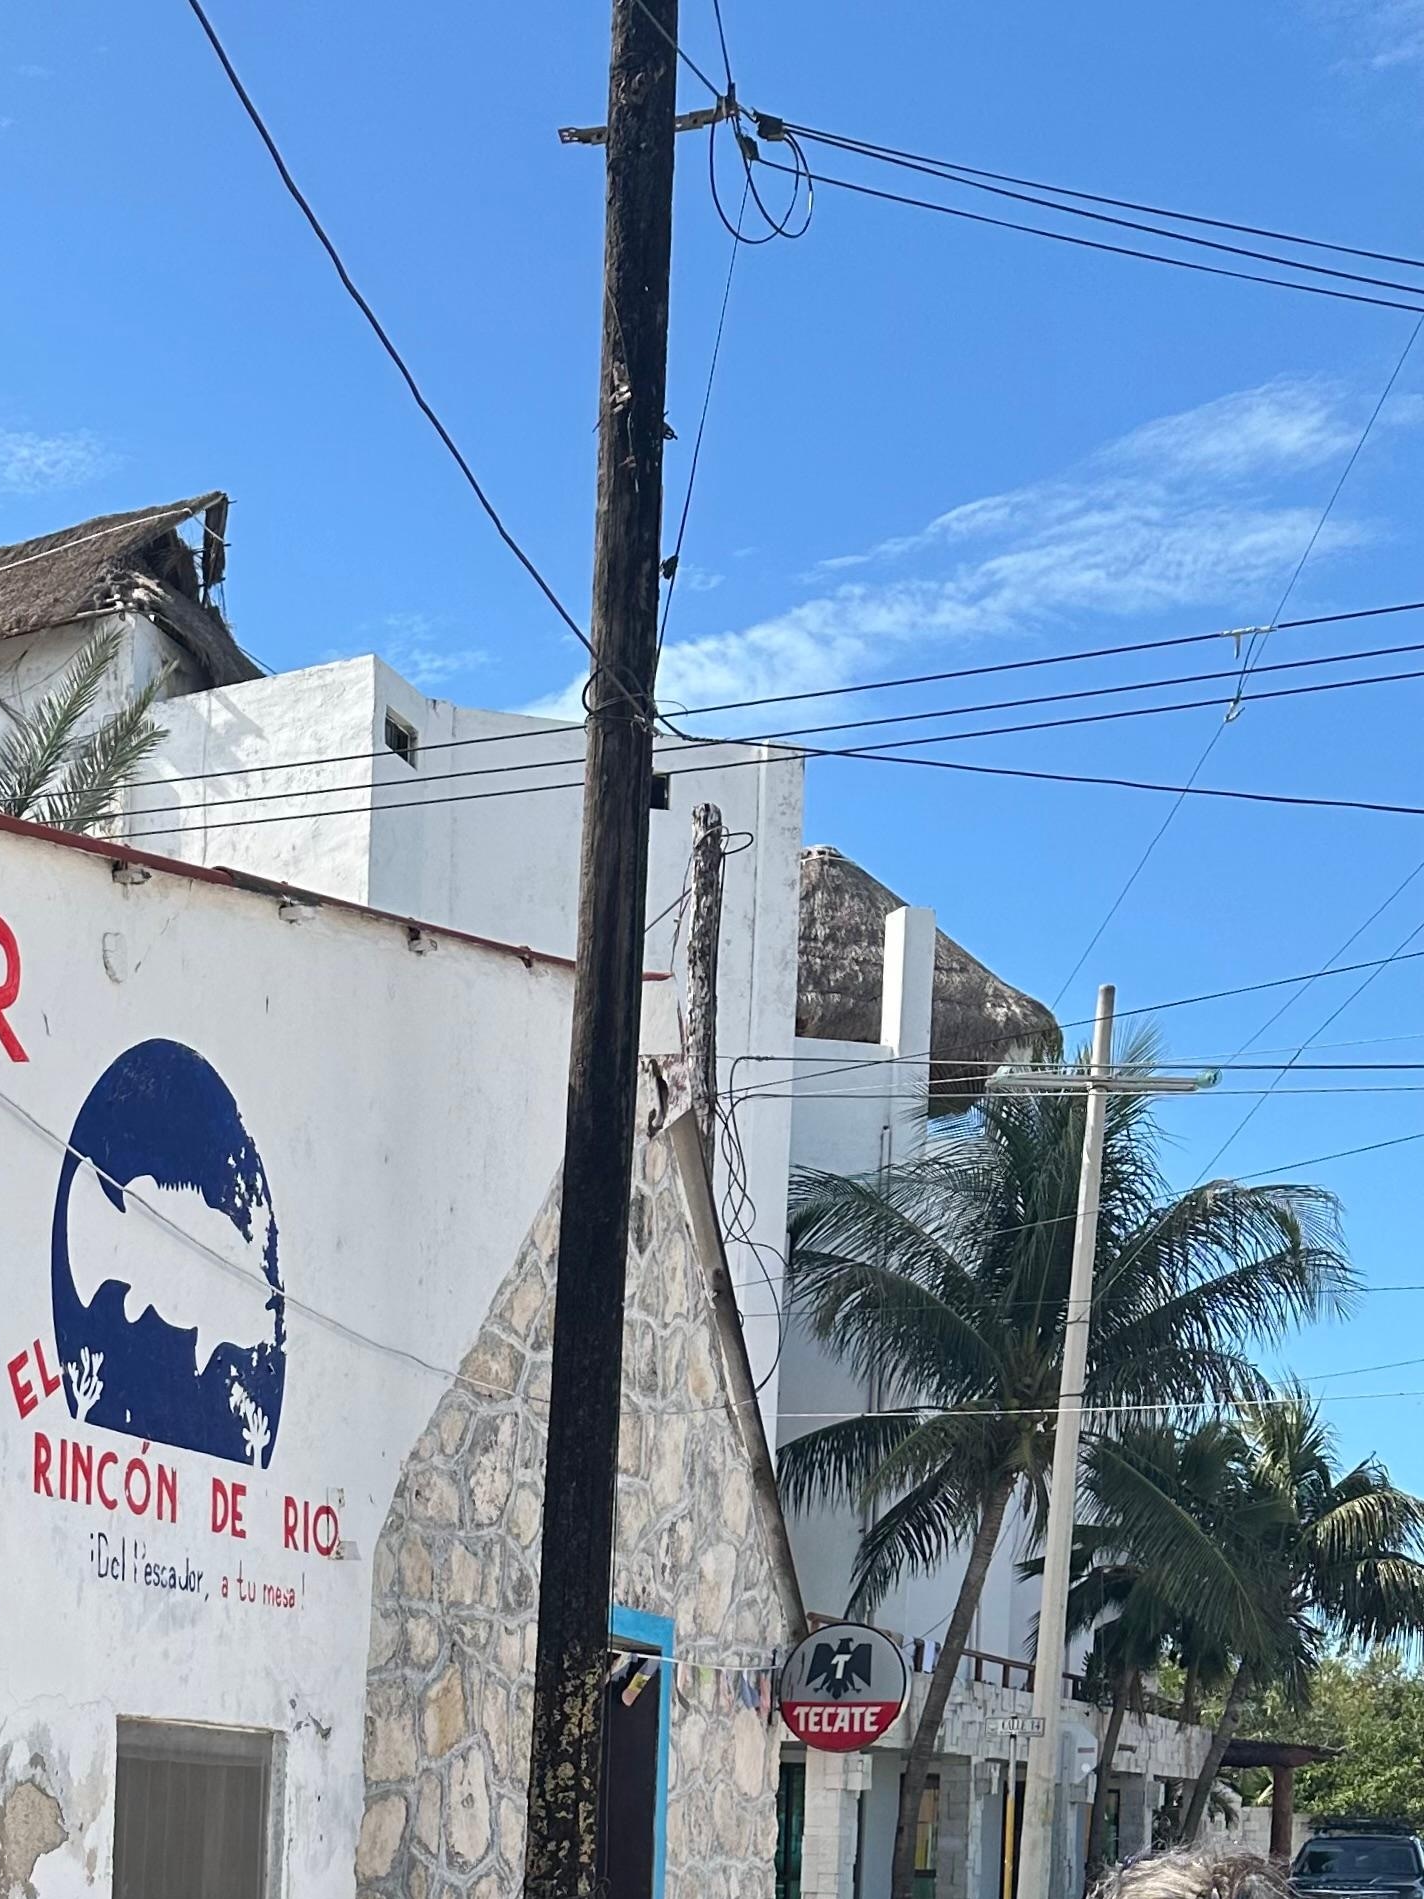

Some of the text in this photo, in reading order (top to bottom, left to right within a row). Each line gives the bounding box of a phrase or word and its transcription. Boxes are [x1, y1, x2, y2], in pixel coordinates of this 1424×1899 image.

[7, 1338, 61, 1420] EL
[33, 1431, 340, 1557] RINCÓN DE RIO
[221, 1575, 229, 1599] a
[236, 1559, 256, 1603] tu
[792, 1705, 882, 1733] TECATE
